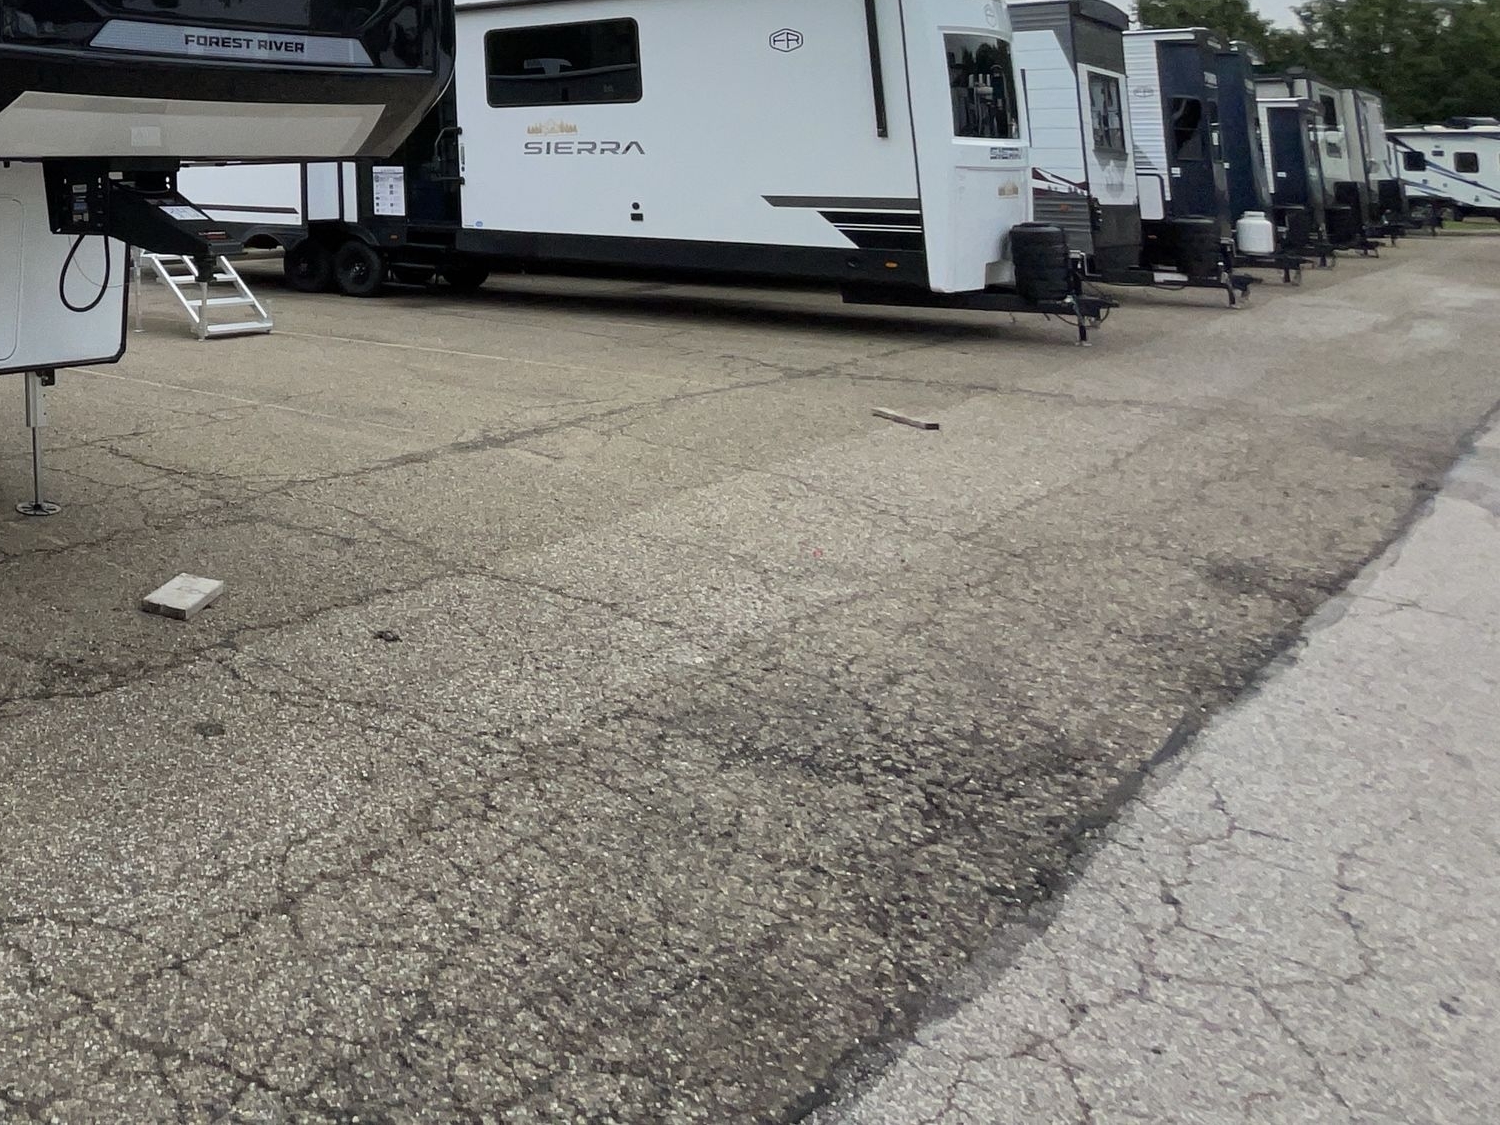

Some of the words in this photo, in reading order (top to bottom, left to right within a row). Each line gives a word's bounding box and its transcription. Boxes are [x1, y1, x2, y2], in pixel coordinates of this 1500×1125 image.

[184, 34, 254, 50] FOREST
[257, 40, 305, 54] RIVER
[523, 140, 646, 155] SIERRA
